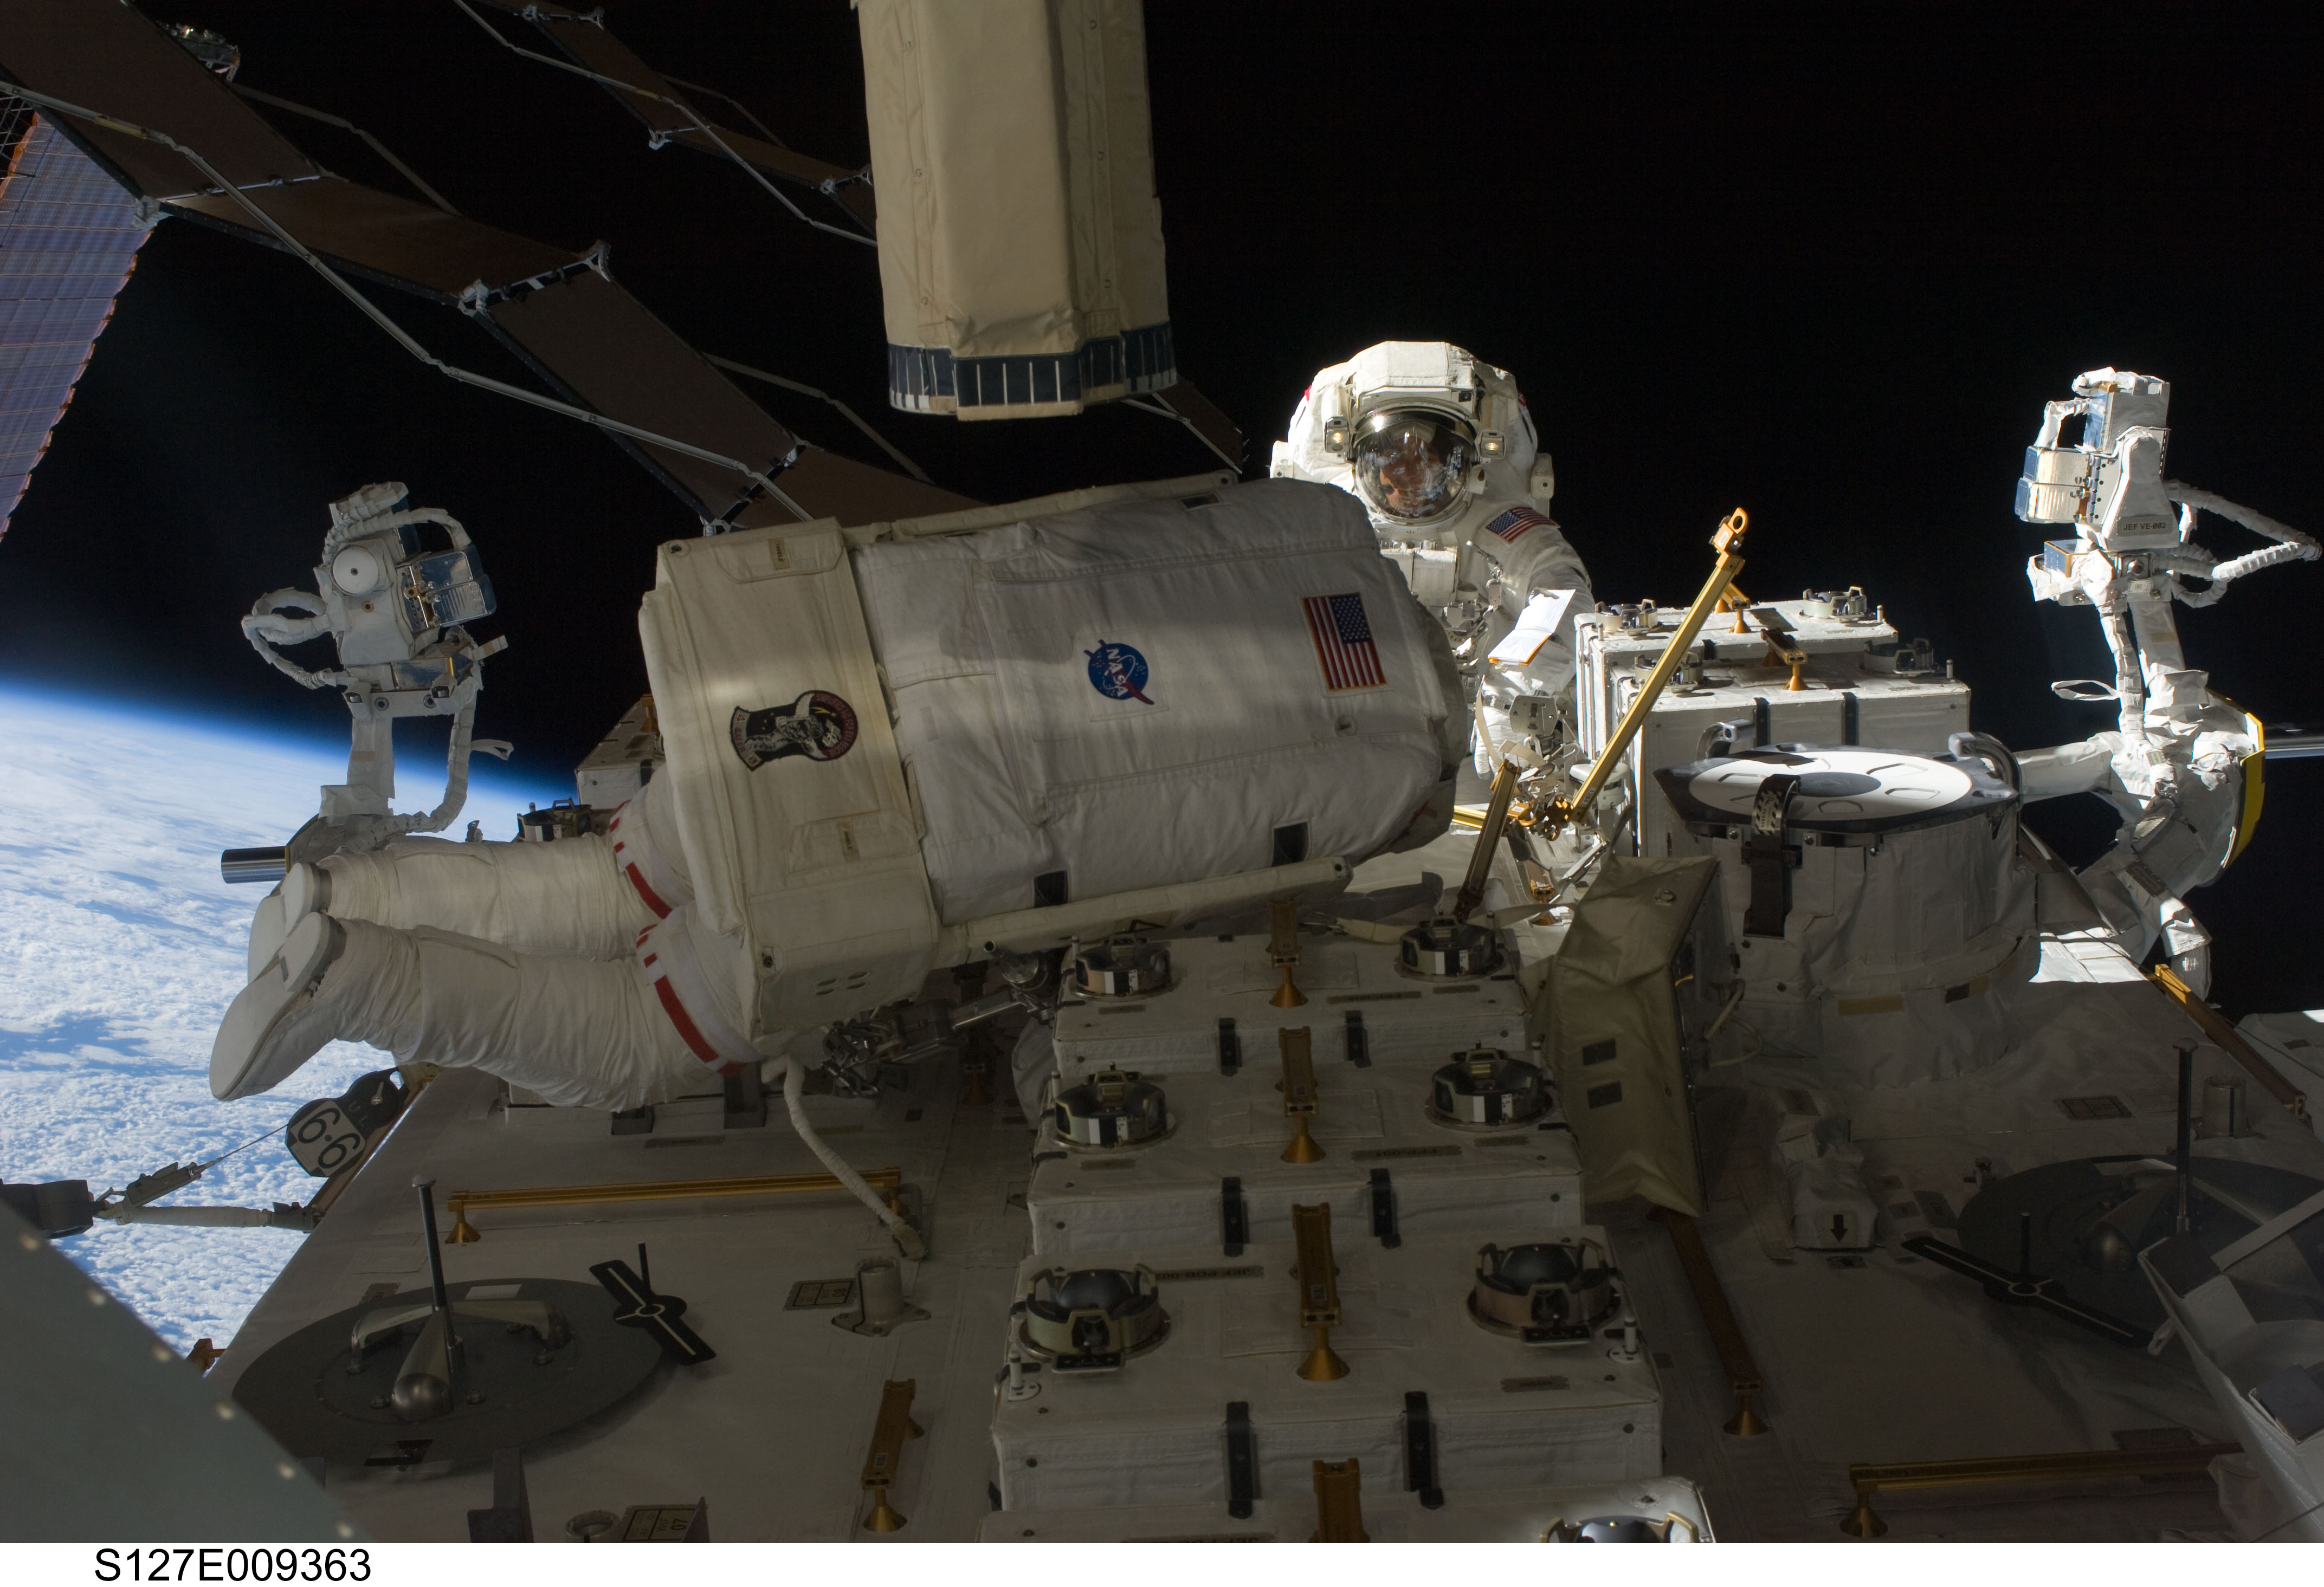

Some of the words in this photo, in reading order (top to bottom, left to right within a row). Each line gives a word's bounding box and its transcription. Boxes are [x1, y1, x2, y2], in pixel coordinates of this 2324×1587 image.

[2140, 522, 2166, 530] VE-002
[1107, 648, 1129, 697] NASA
[734, 728, 746, 753] SAFER
[672, 1518, 688, 1530] 07
